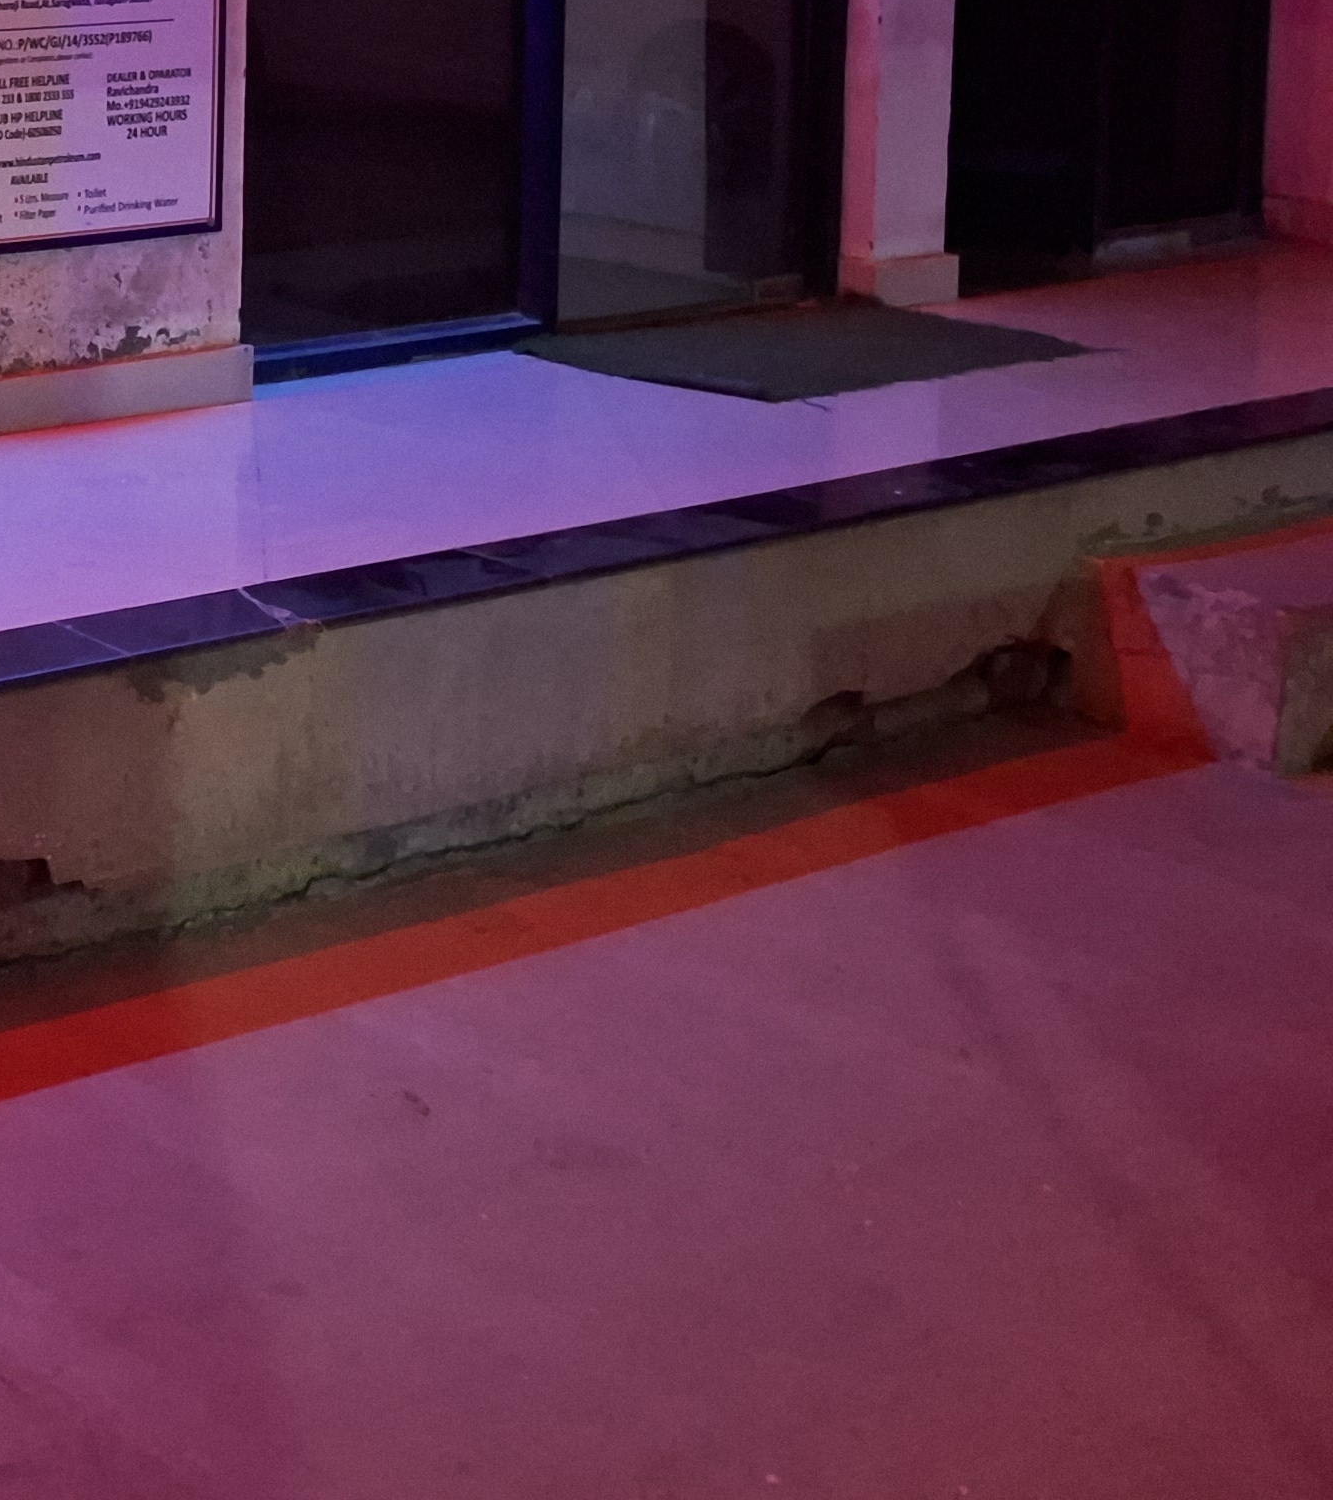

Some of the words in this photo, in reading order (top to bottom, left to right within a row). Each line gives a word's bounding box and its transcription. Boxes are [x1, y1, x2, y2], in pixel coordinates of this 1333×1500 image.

[10, 76, 29, 88] FREE
[31, 73, 70, 87] HELPLINE
[107, 71, 137, 83] DEALER
[25, 108, 63, 123] HELPLINE
[106, 111, 153, 127] WORKING
[155, 108, 187, 122] HOURS
[126, 127, 137, 140] 24
[140, 124, 167, 139] HOUR
[117, 200, 152, 212] Drinking
